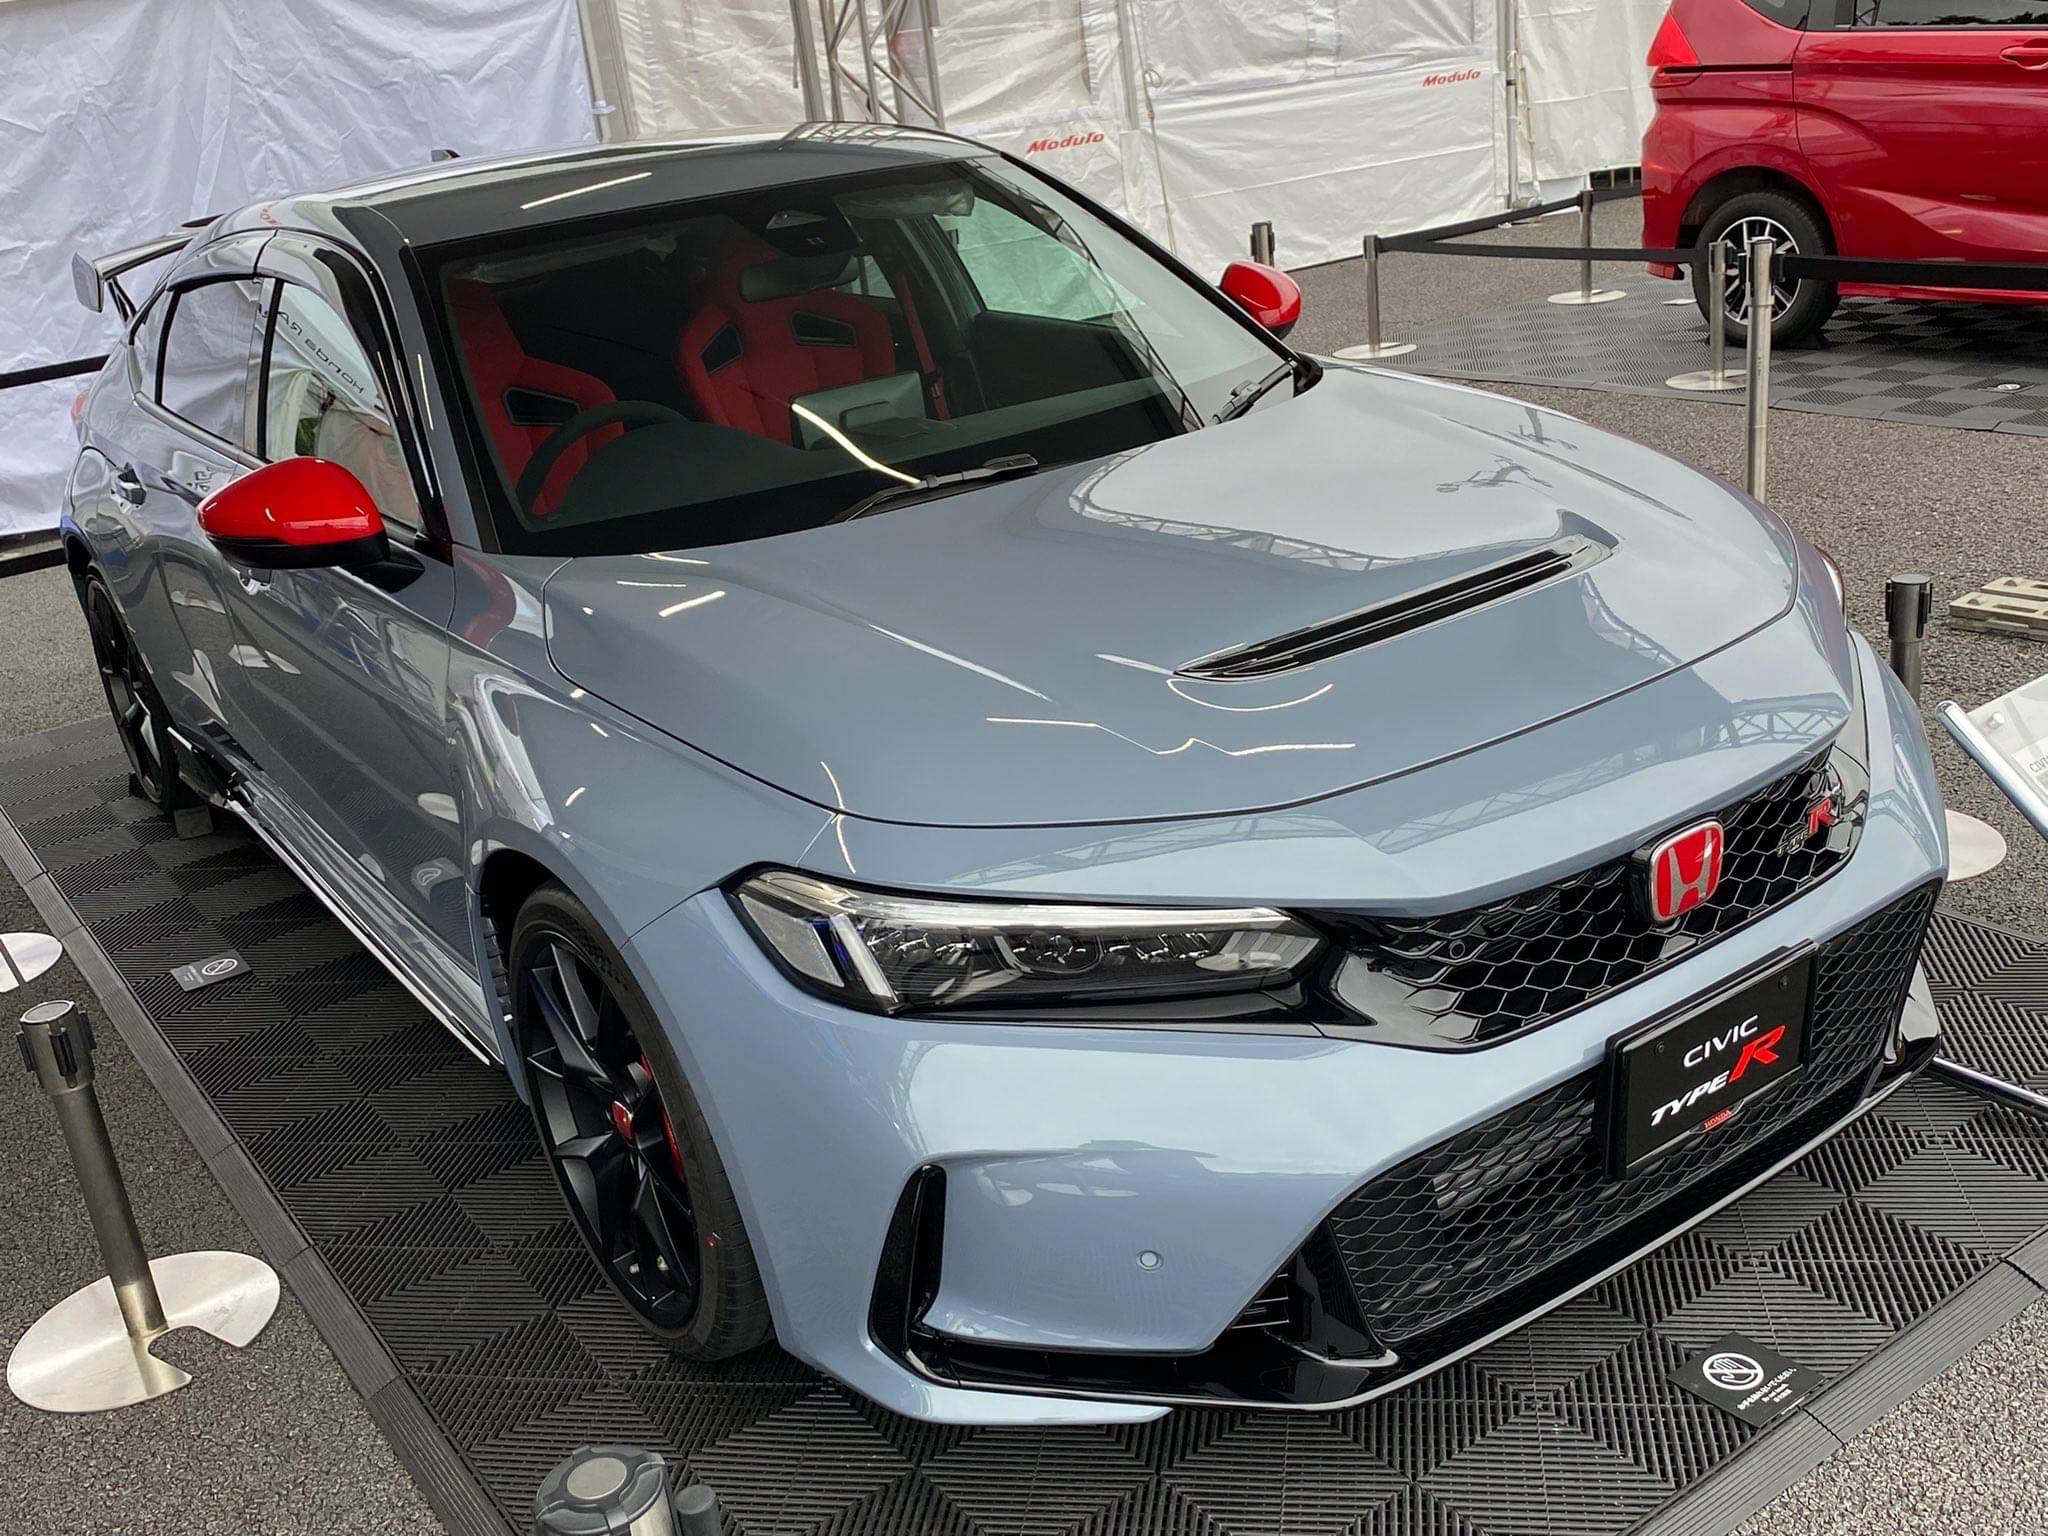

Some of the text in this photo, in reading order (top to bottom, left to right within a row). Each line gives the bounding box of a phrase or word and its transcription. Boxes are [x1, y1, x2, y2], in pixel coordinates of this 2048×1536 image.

[1423, 69, 1481, 87] Modulo
[1027, 131, 1105, 153] Modulo
[1807, 797, 1836, 837] R
[1683, 1014, 1759, 1068] CIVIC
[1651, 1025, 1786, 1127] TYPE R
[1704, 1110, 1732, 1129] HONDA
